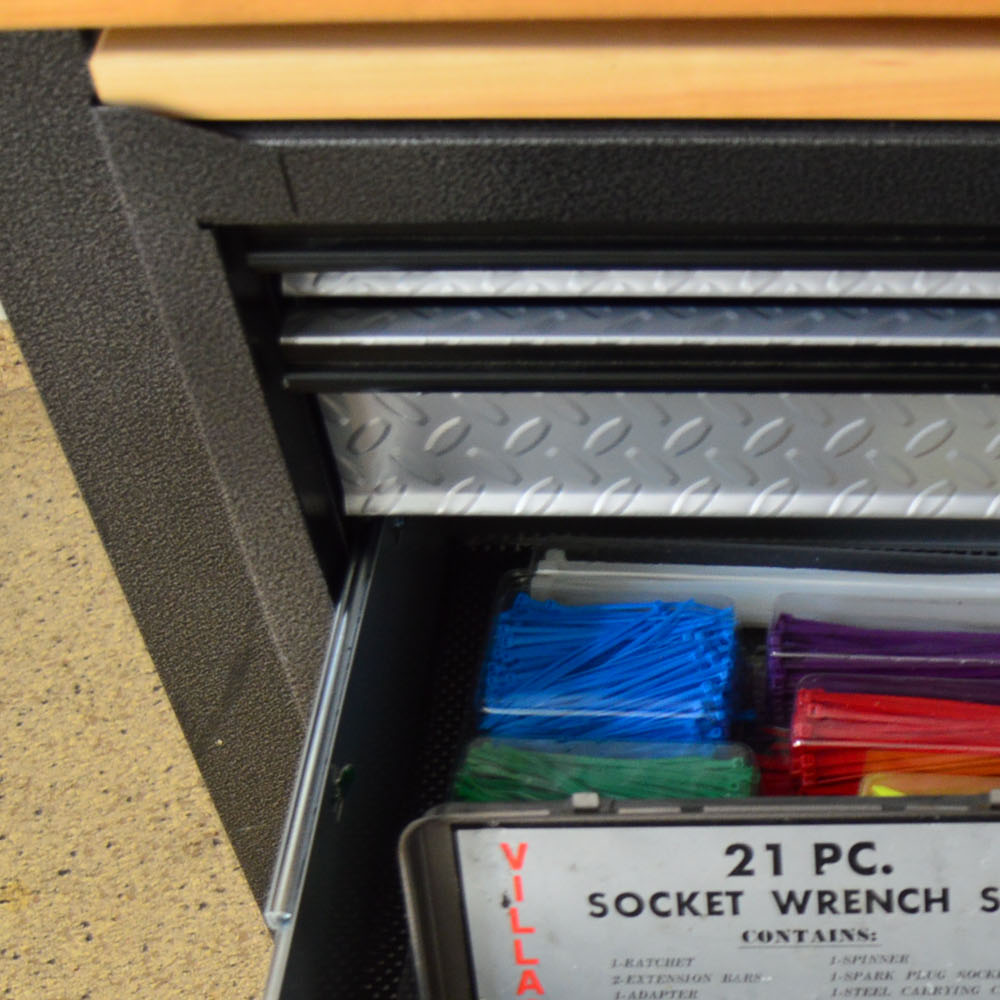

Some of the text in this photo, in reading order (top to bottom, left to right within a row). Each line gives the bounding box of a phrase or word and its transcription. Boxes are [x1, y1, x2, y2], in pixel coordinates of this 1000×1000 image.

[724, 841, 894, 877] 21 PC.
[587, 890, 744, 918] SOCKET
[771, 888, 950, 915] WRENCH
[741, 928, 878, 943] CONTAINS:
